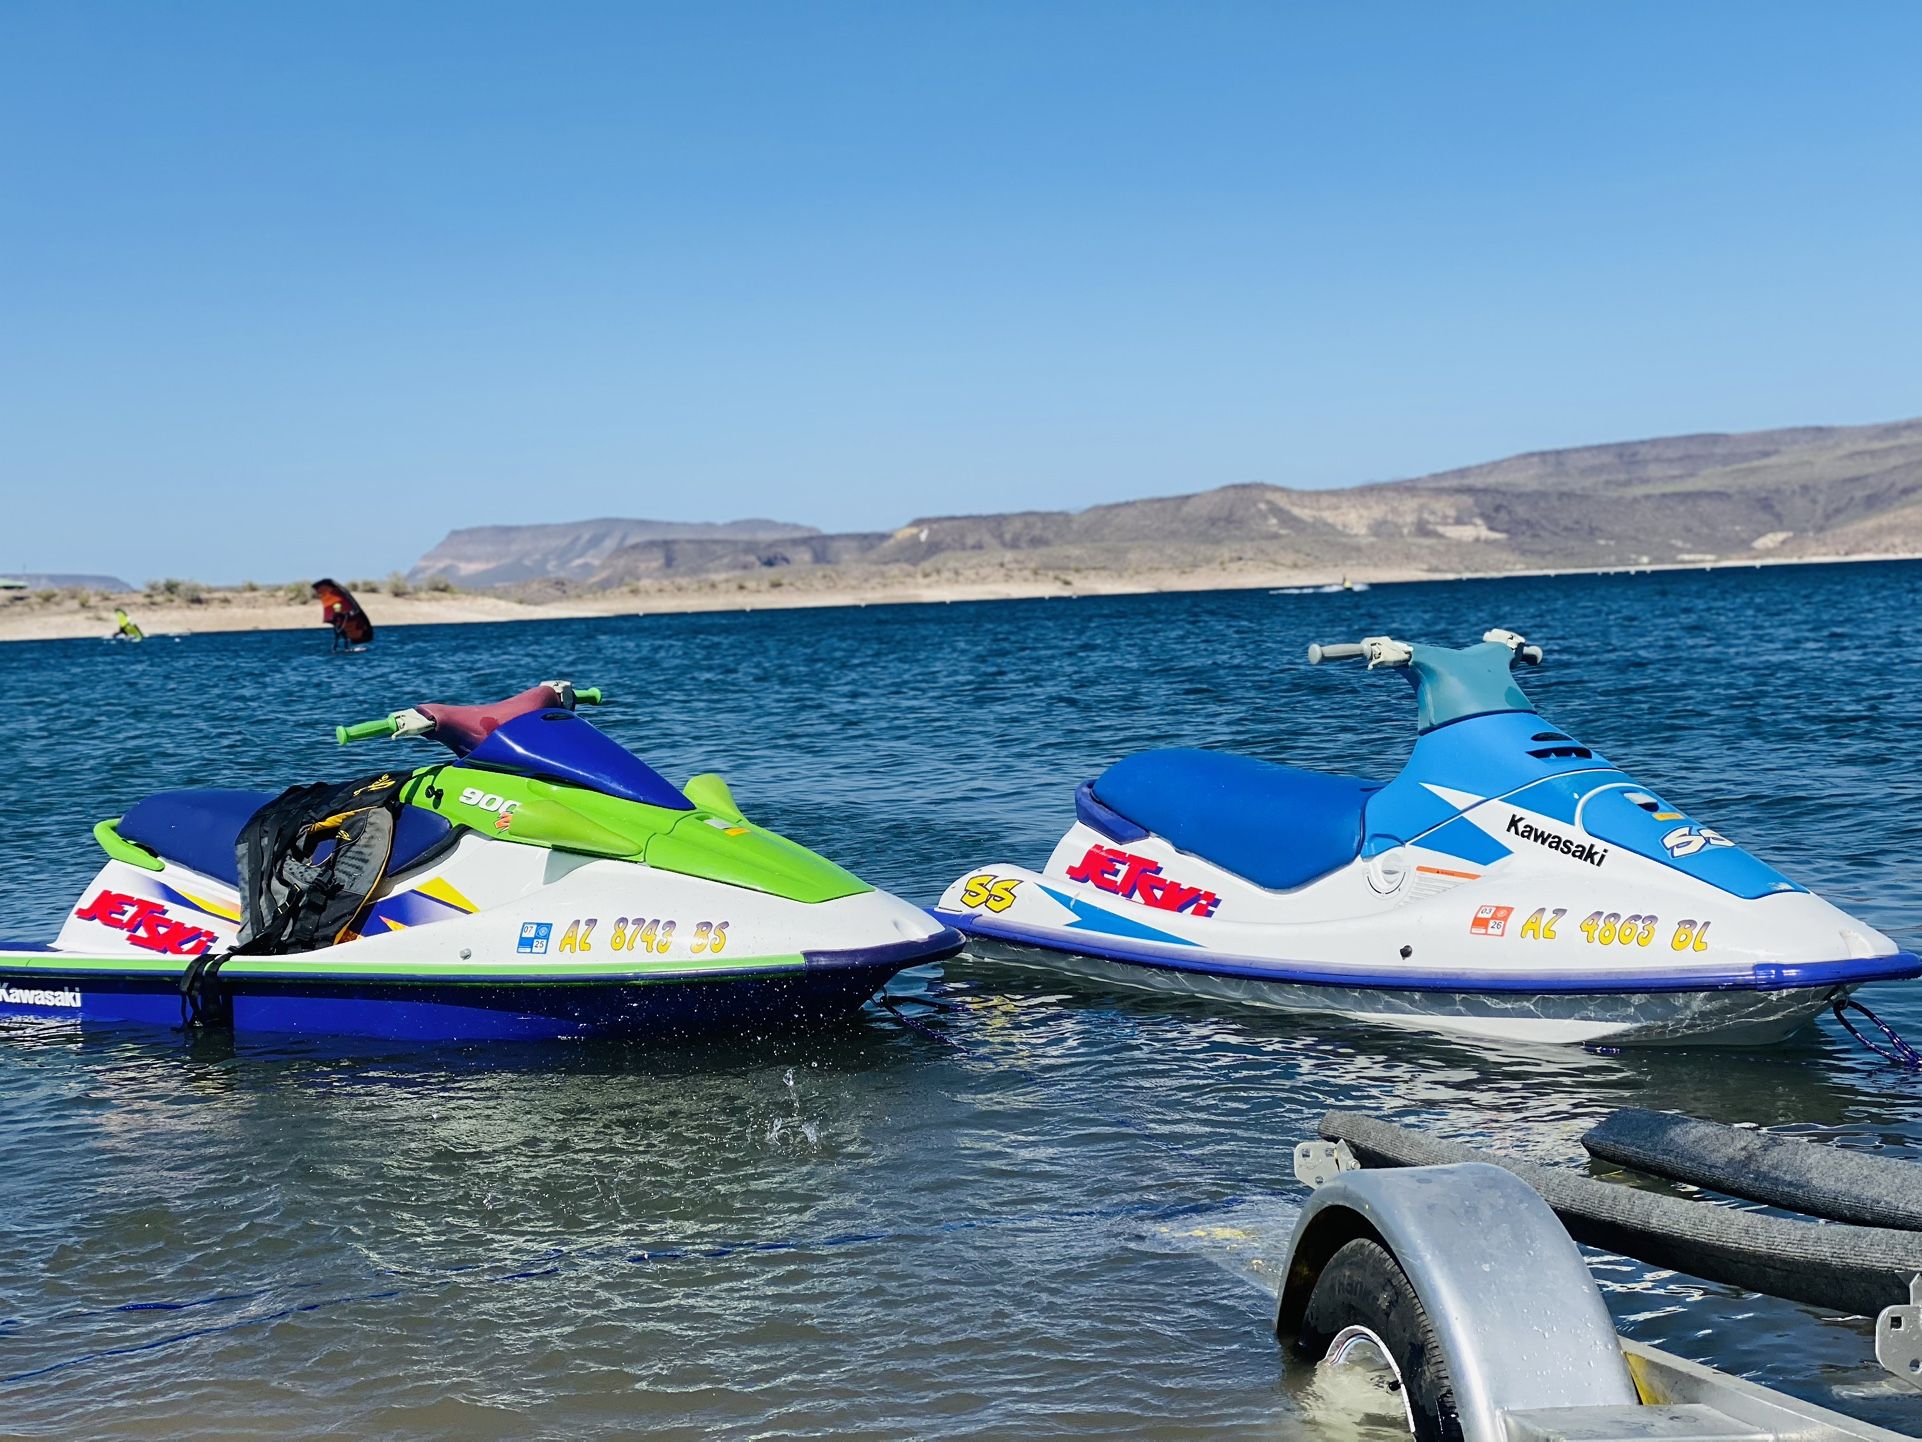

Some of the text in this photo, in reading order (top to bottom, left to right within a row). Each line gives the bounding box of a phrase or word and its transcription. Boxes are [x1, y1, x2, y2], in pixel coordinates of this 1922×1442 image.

[1506, 814, 1609, 867] Kawasaki
[960, 874, 1024, 913] SS
[1480, 907, 1493, 915] 03
[523, 925, 534, 934] 07
[559, 917, 730, 954] AZ 8743 BS
[1490, 920, 1503, 930] 26
[1520, 907, 1711, 952] AZ 4863 BL
[534, 940, 545, 949] 25
